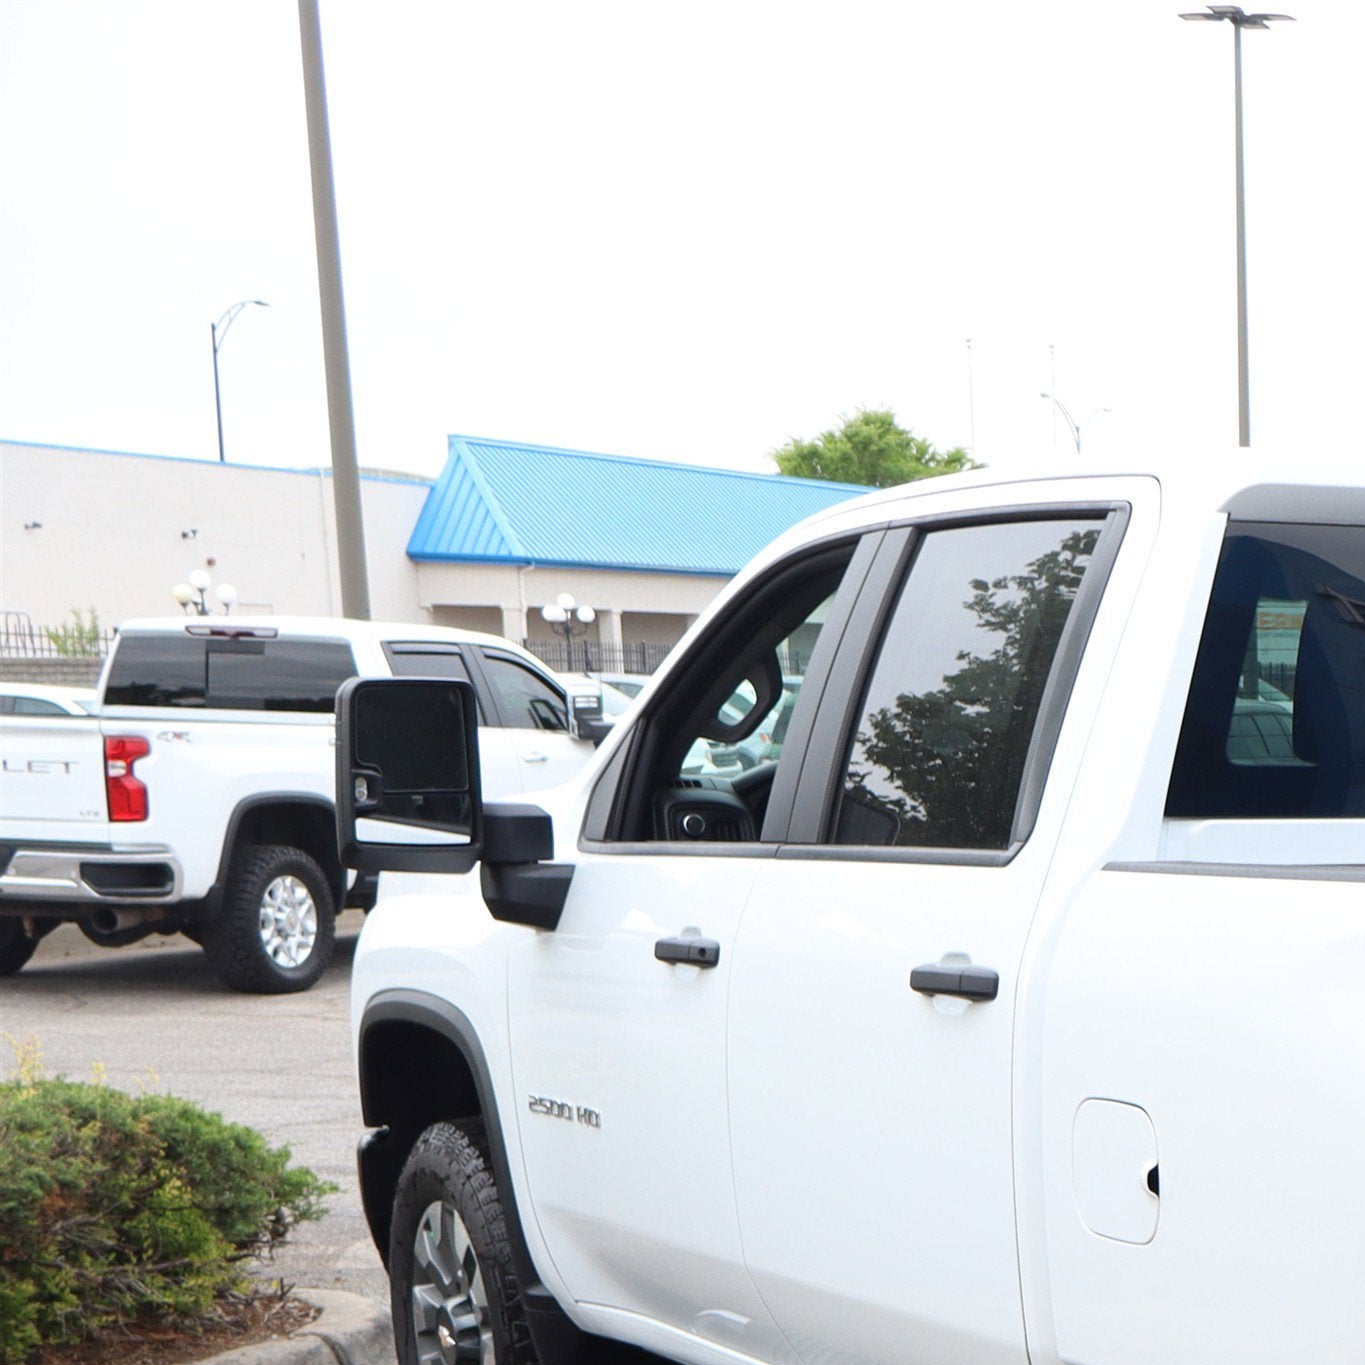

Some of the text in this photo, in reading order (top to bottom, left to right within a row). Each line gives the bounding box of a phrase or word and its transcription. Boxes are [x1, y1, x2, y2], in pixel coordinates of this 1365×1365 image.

[2, 759, 79, 775] LET
[528, 1092, 601, 1128] 2500 HD
